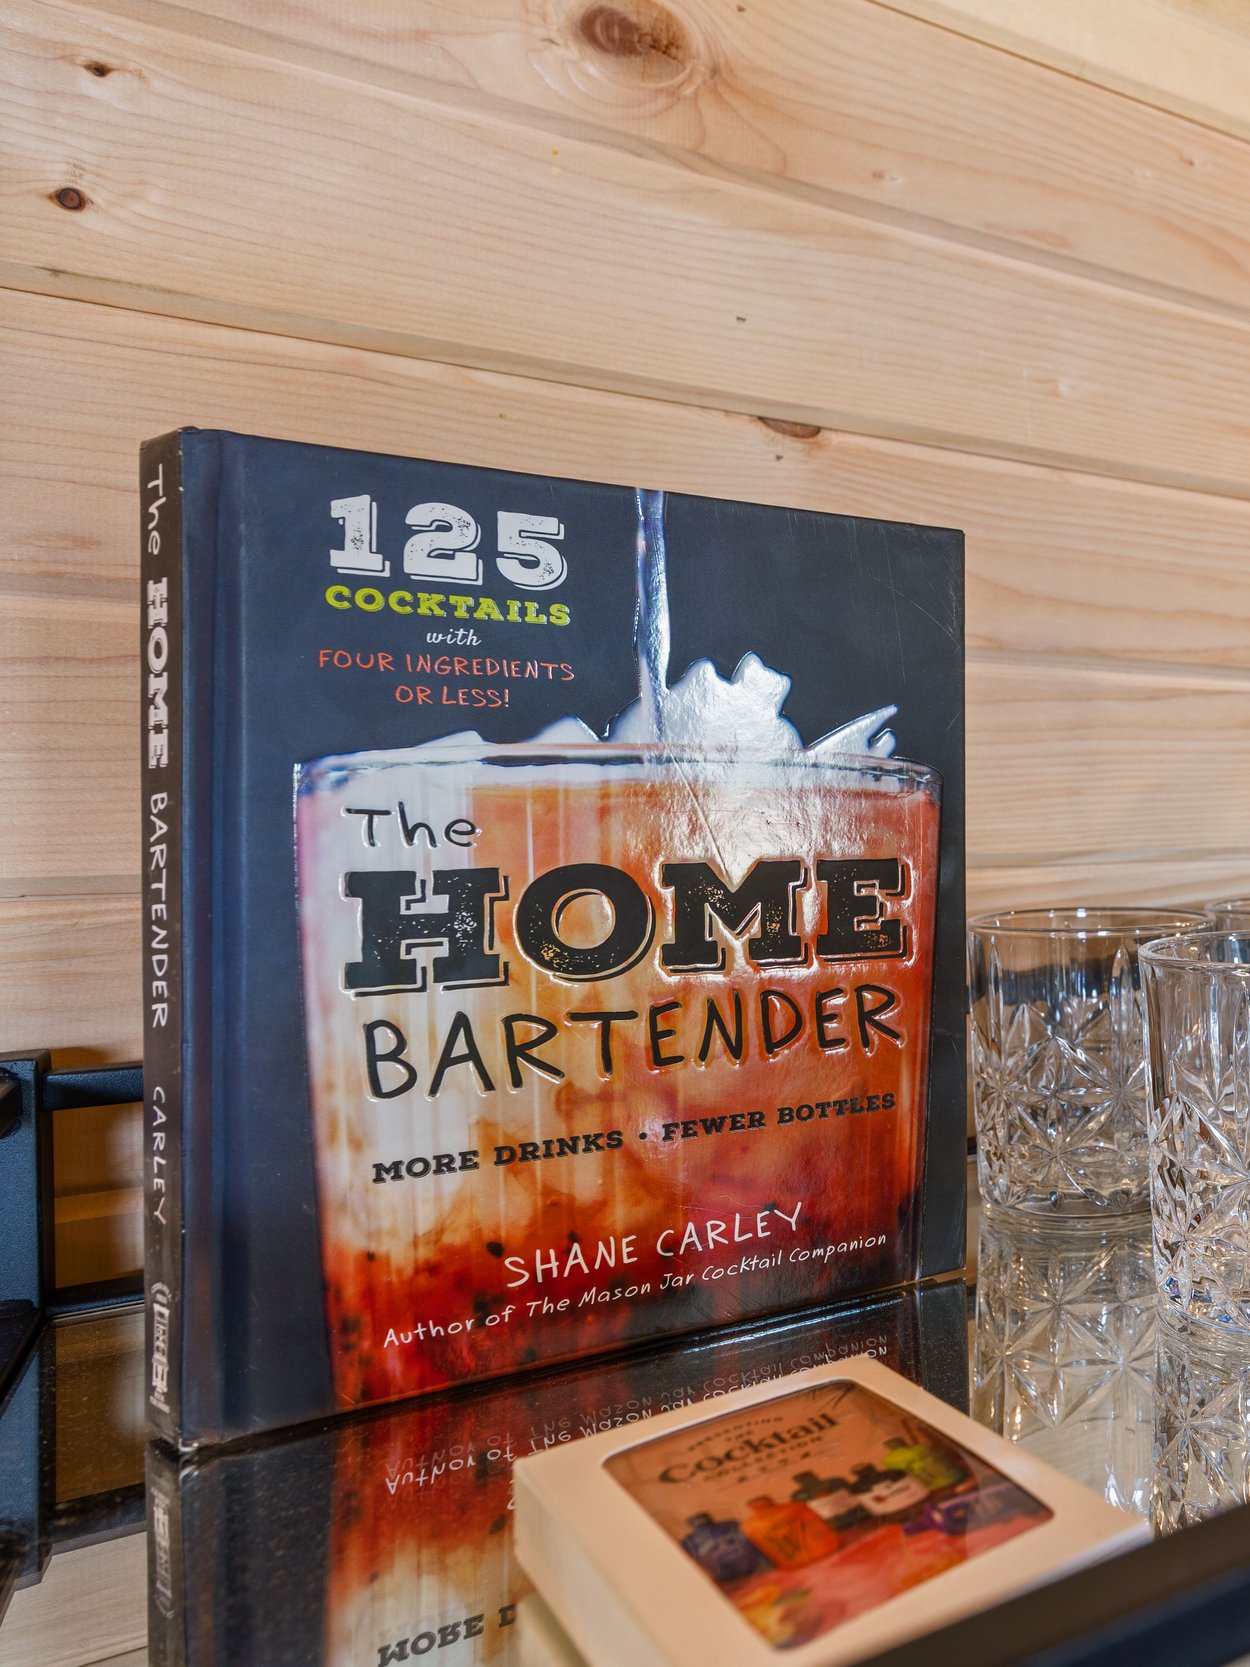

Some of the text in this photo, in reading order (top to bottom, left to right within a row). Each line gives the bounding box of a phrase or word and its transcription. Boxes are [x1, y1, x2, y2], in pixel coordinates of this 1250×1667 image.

[329, 493, 568, 591] 125
[325, 584, 571, 626] COCKTAILS
[426, 627, 482, 647] with
[318, 648, 575, 682] FOUR INGREDIENTS
[395, 685, 510, 708] OR LESS!
[147, 463, 168, 1225] The HOME BARTENDER CARLEY
[345, 801, 479, 848] The
[343, 858, 911, 996] HOME
[363, 984, 904, 1100] BARTENDER
[371, 1092, 897, 1184] MORE DRINKS FEWER BOTTLES
[504, 1200, 802, 1288] SHANE CARLEY
[383, 1233, 888, 1349] Author of The Mason Jar Cocktail Companion
[658, 1413, 840, 1484] Cocktail
